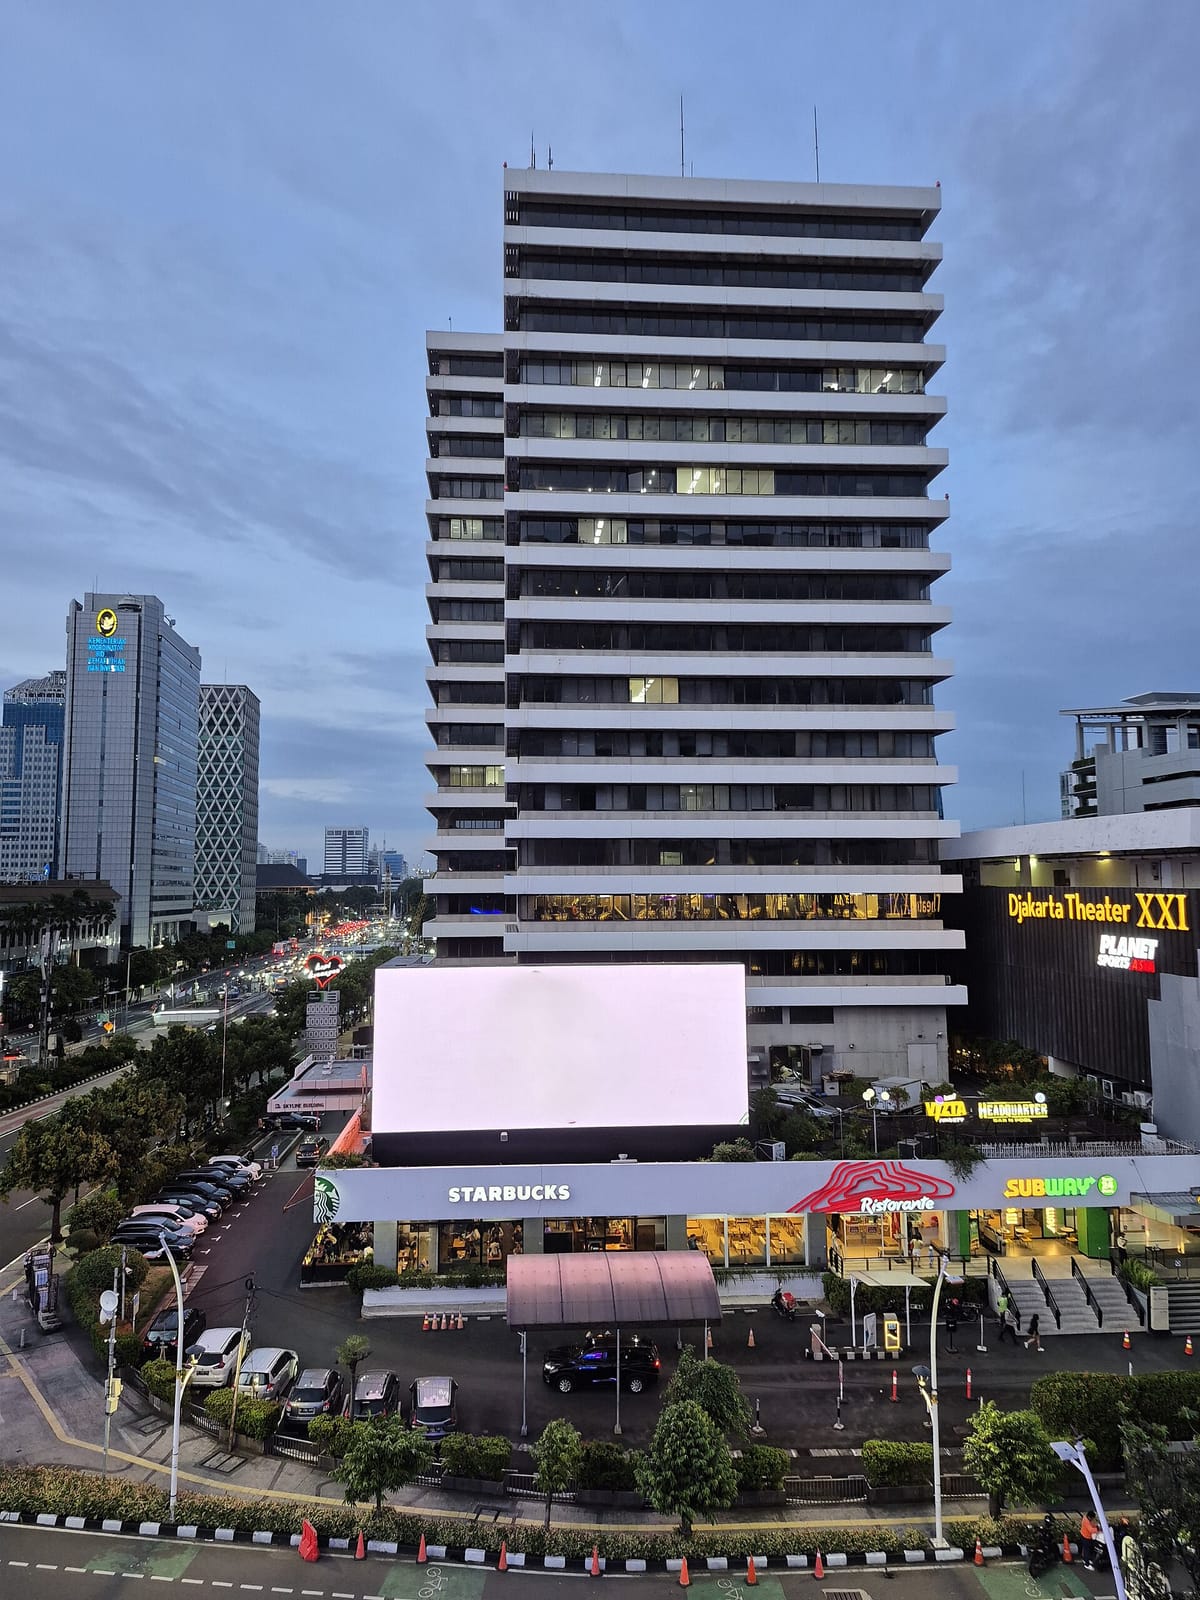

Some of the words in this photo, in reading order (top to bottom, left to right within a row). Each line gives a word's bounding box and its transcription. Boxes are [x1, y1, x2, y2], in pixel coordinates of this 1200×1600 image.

[1008, 892, 1064, 924] Djakarta
[1064, 893, 1131, 923] Theater
[1135, 893, 1190, 931] XXI
[1100, 934, 1159, 960] PLANET
[1097, 954, 1131, 969] SPORTS
[978, 1102, 1048, 1118] HEADQUARTER
[448, 1184, 570, 1202] STARBUCKS
[1003, 1176, 1096, 1198] SUBWAY
[860, 1196, 935, 1215] Ristorante
